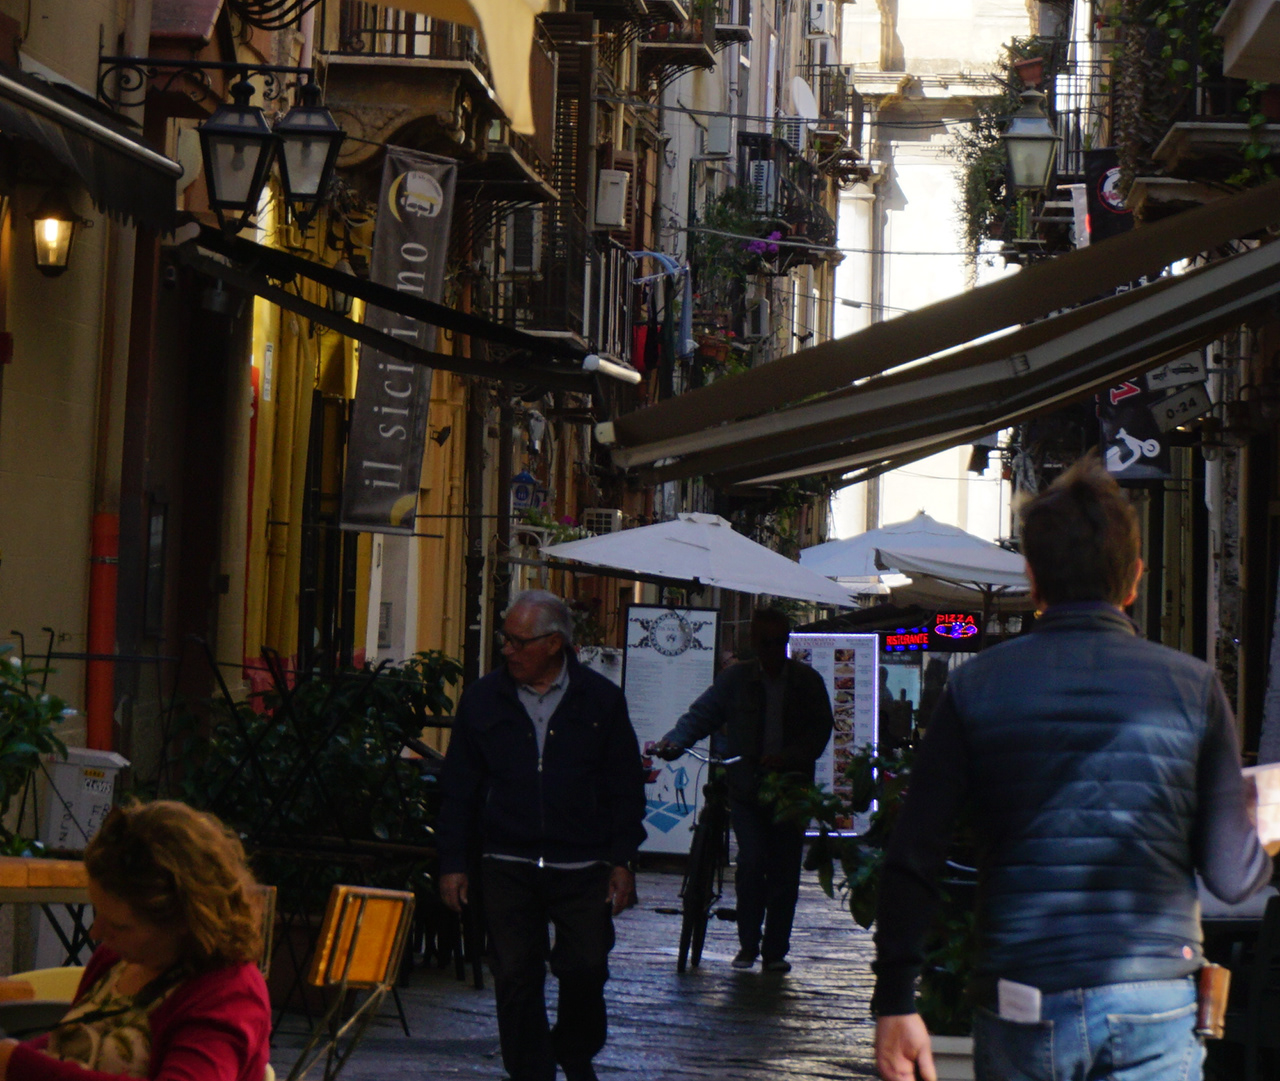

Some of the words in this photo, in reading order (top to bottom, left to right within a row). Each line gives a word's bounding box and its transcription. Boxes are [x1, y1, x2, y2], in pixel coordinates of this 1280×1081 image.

[374, 242, 428, 440] siciino
[1166, 397, 1197, 419] 0-24
[362, 461, 403, 489] il
[936, 613, 975, 624] PIZZA
[886, 633, 928, 645] RISTORANTE
